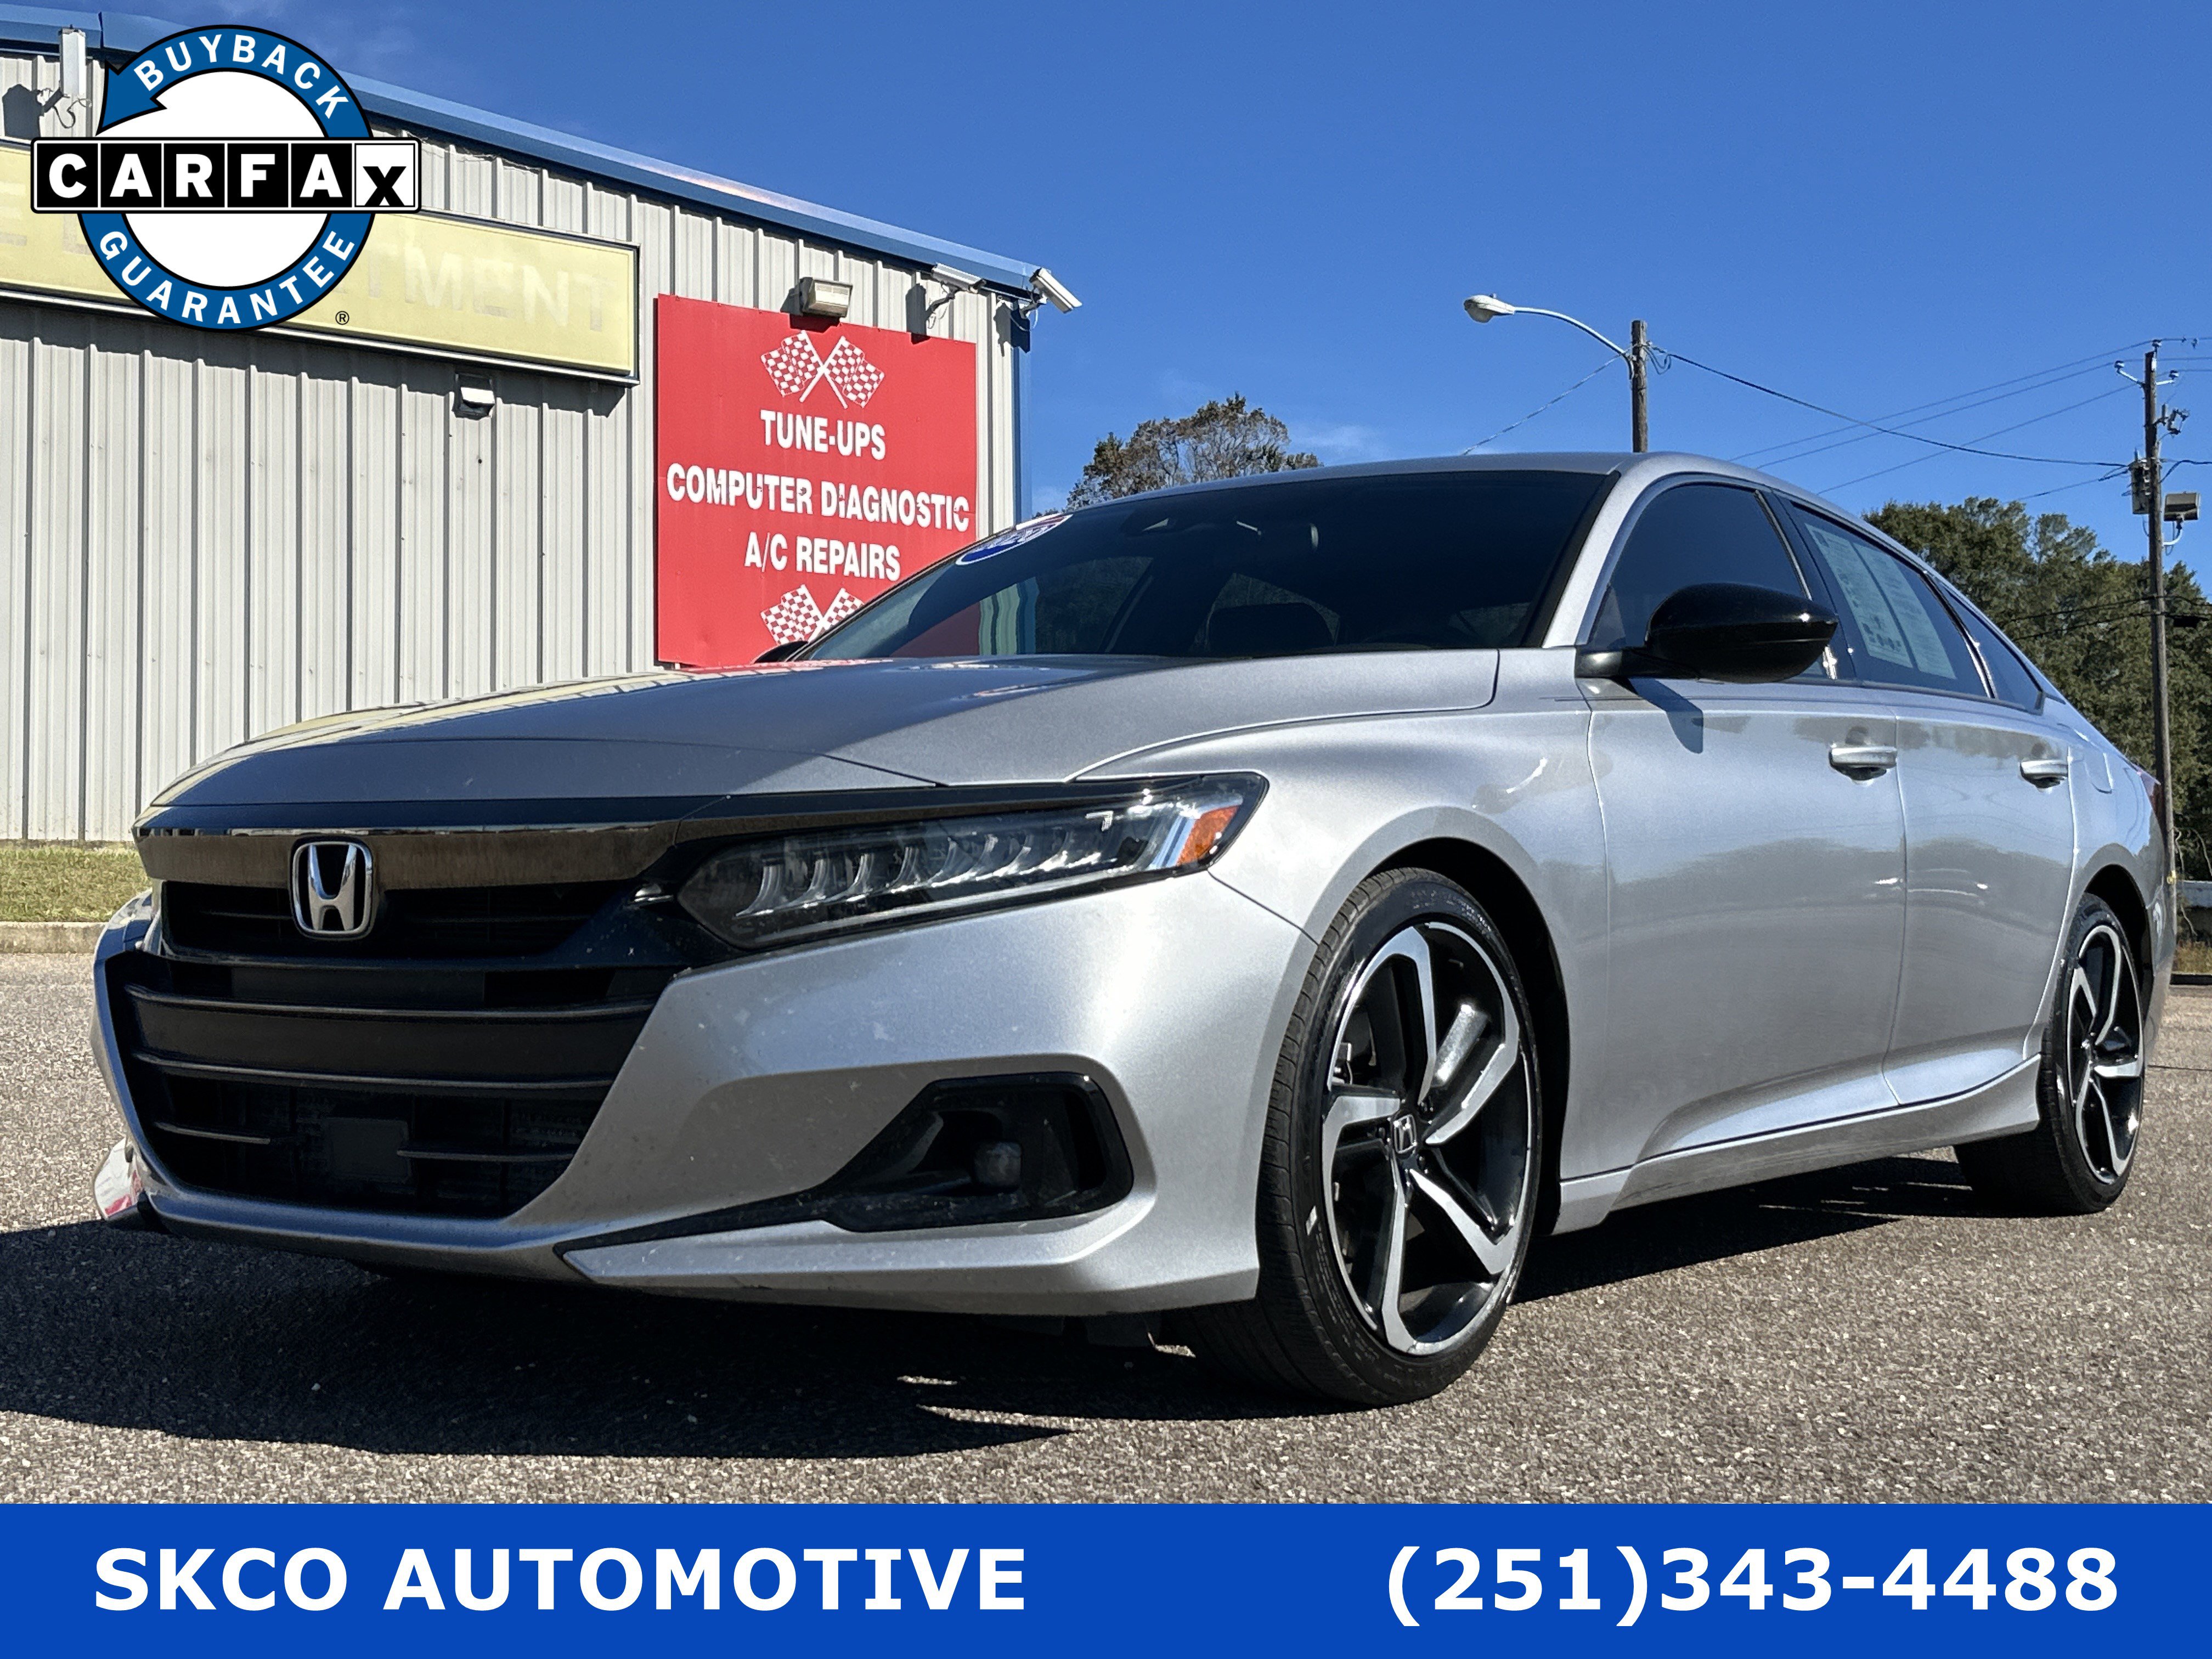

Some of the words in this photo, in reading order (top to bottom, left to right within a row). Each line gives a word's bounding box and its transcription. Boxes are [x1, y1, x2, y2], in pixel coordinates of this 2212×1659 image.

[761, 410, 886, 460] TUNE-UPS
[667, 463, 813, 515] COMPUTER
[821, 481, 969, 532] DIAGNOSTIC
[744, 532, 788, 572] A/C
[797, 537, 900, 582] REPAIRS
